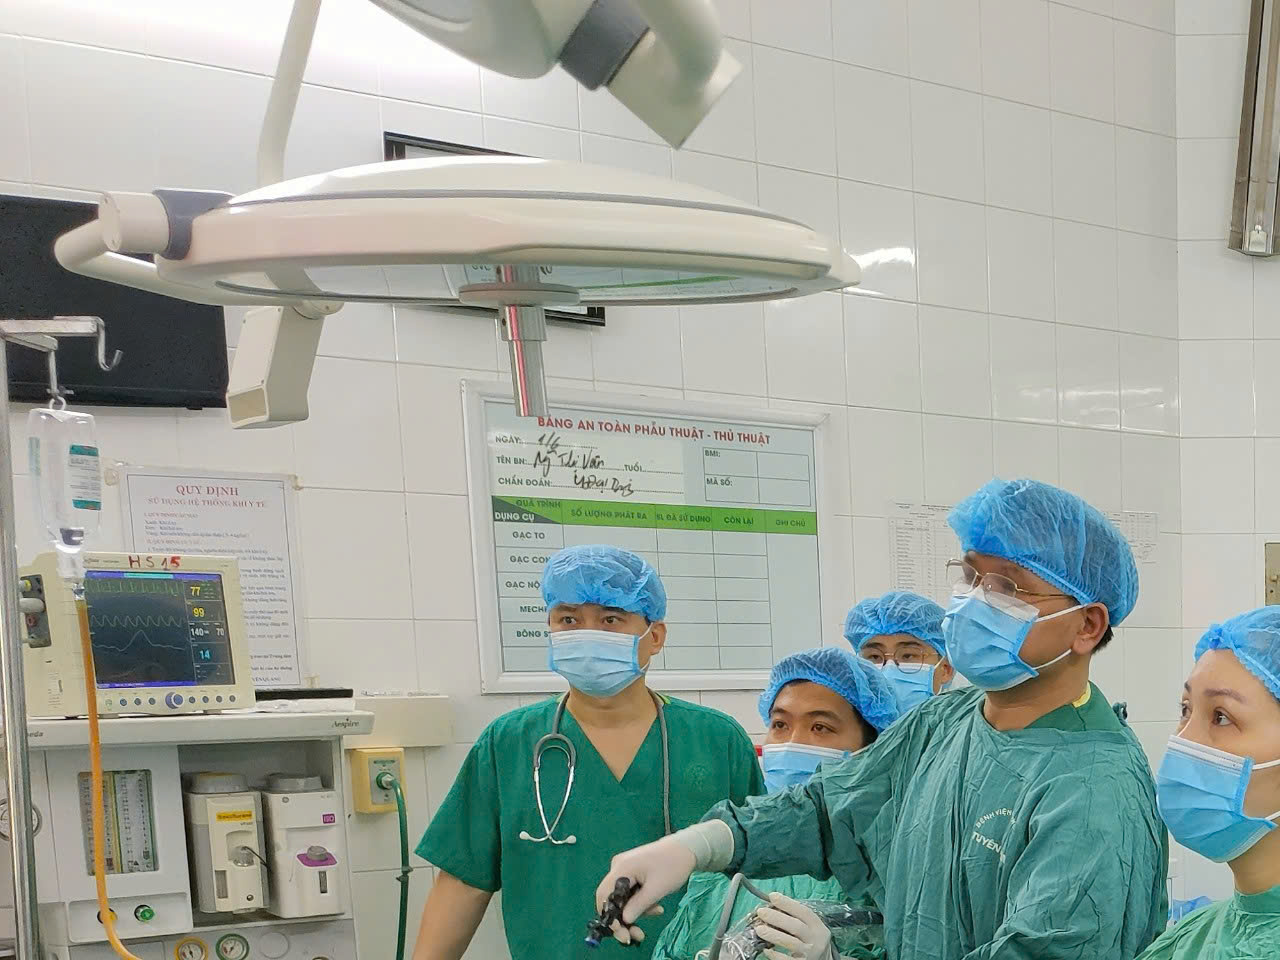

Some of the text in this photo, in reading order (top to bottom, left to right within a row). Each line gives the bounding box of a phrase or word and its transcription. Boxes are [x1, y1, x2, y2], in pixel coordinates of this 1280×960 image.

[578, 419, 595, 431] AN
[598, 420, 631, 433] TOÀN
[669, 426, 704, 441] THUẬT
[714, 429, 734, 442] THỦ
[737, 432, 770, 447] THUẬT
[176, 485, 239, 497] QUY ĐỊNH
[513, 531, 532, 540] GẠC
[510, 556, 529, 565] GẠC
[505, 580, 541, 590] GẠC NỘ
[190, 586, 200, 596] 77
[193, 607, 205, 617] 99
[199, 650, 210, 659] 14
